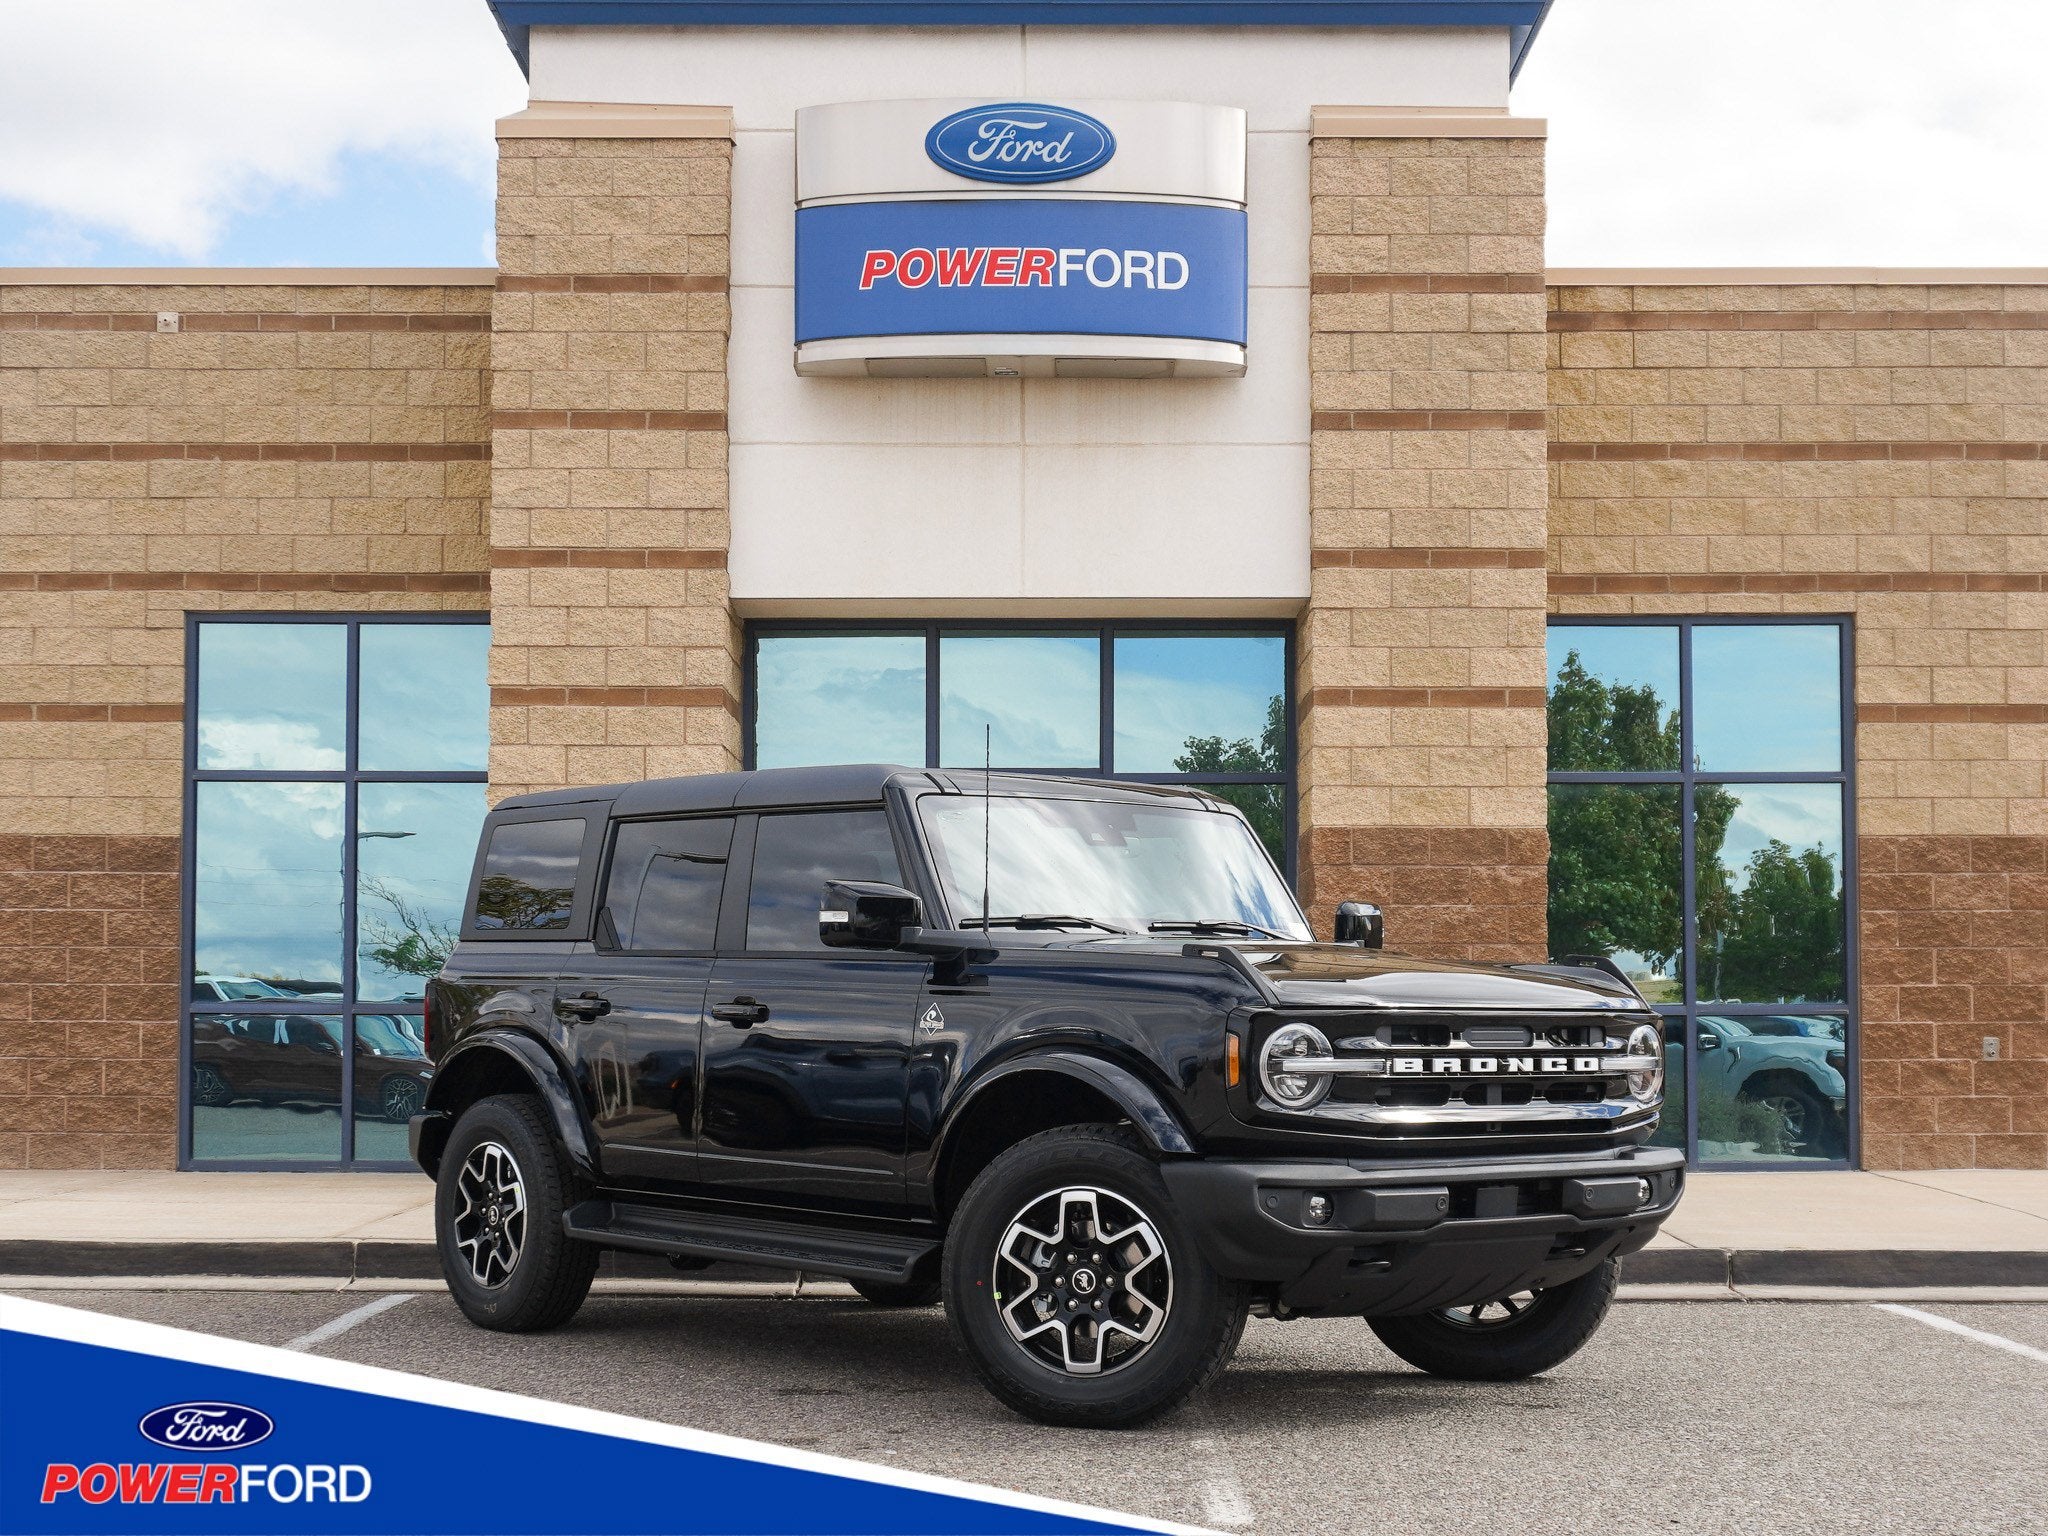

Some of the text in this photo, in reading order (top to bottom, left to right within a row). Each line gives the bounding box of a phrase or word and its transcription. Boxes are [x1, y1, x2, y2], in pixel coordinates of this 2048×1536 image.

[967, 118, 1074, 163] Ford
[858, 246, 1190, 290] POWERFORD
[1392, 1057, 1600, 1073] BRONCO
